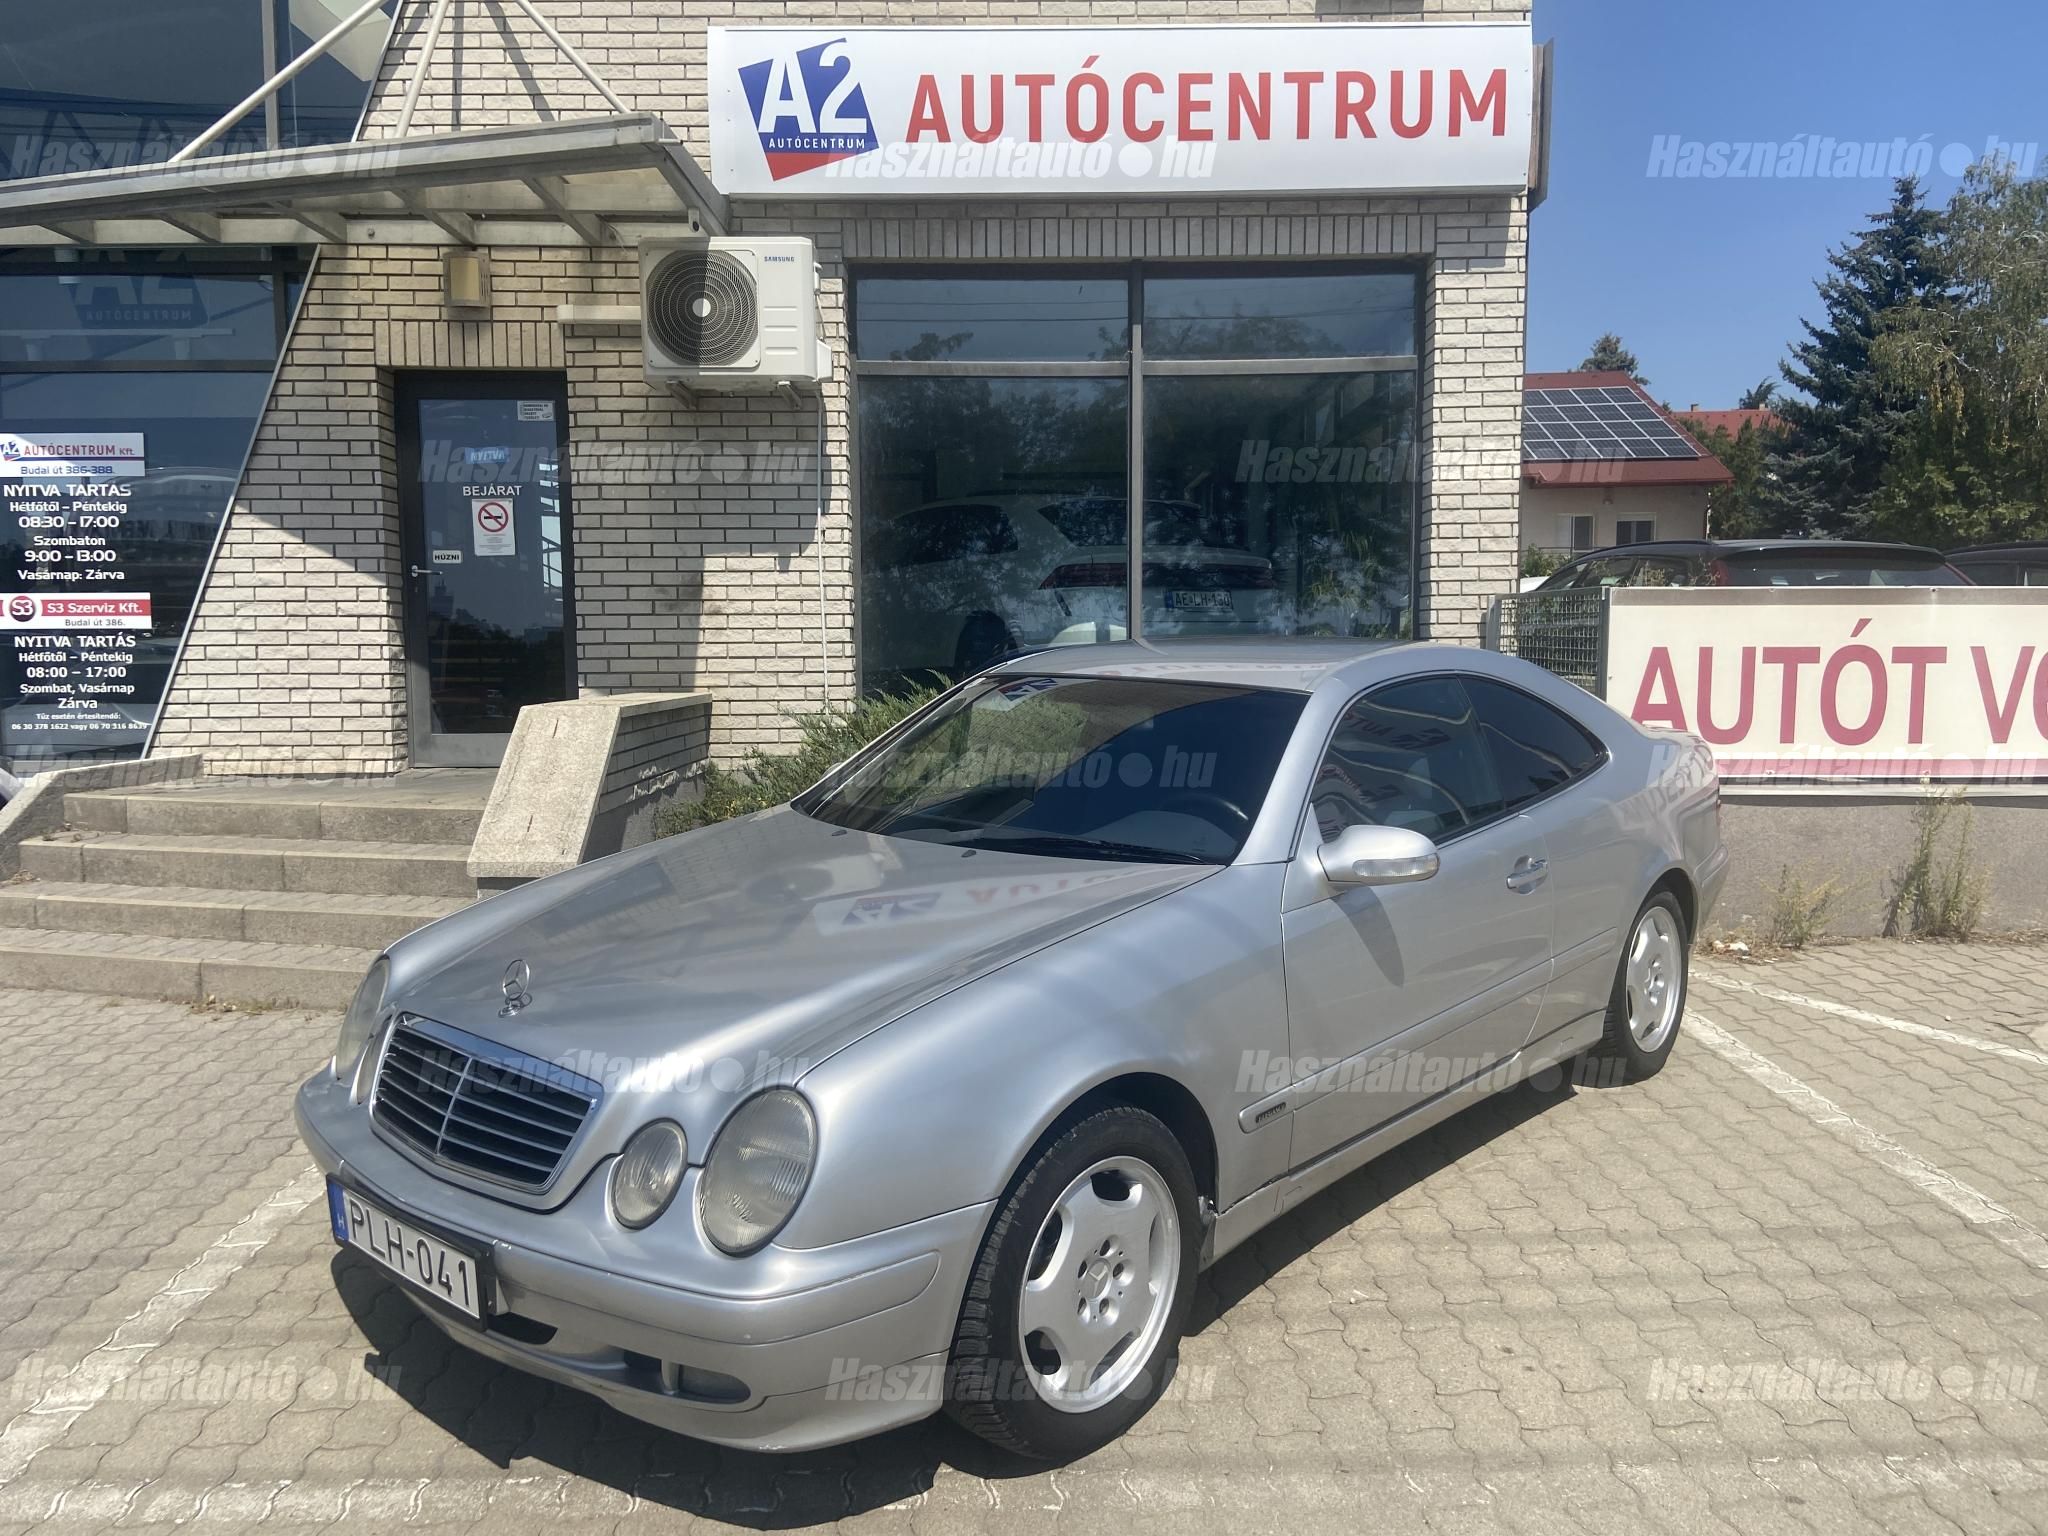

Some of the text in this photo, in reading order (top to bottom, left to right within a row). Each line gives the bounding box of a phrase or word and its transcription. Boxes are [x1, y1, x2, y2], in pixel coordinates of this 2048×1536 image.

[757, 38, 867, 134] A2
[905, 55, 1507, 144] AUTÓCENTRUM
[768, 135, 866, 150] AUTÓCENTRUM
[24, 443, 116, 456] AUTÓCENTRUM
[119, 448, 135, 456] Kft.
[21, 466, 50, 475] Budai
[53, 466, 63, 475] út
[3, 484, 61, 497] NYITVA
[462, 483, 522, 496] BEJÁRAT
[10, 501, 60, 512] Hétfőtől
[72, 501, 128, 514] Péntekig
[18, 516, 65, 528] 08:30
[80, 515, 120, 528] 17:00
[33, 535, 106, 546] Szombaton
[24, 550, 62, 562] 9:00
[76, 549, 117, 562] 13:00
[17, 568, 125, 580] Vasárnap: Zárva
[11, 599, 34, 616] S3
[47, 601, 143, 613] S3 Szerviz Kft.
[65, 618, 126, 627] Budai út 386.
[14, 632, 137, 648] NYITVA TARTÁS
[18, 652, 67, 662] Hétfőtől
[81, 652, 133, 664] Péntekig
[26, 666, 68, 678] 08:00
[85, 666, 127, 678] 17:00
[20, 682, 135, 694] Szombat, Vasárnap
[1631, 617, 1948, 746] AUTÓT
[58, 697, 98, 709] Zárva
[350, 1198, 470, 1307] PLH-041
